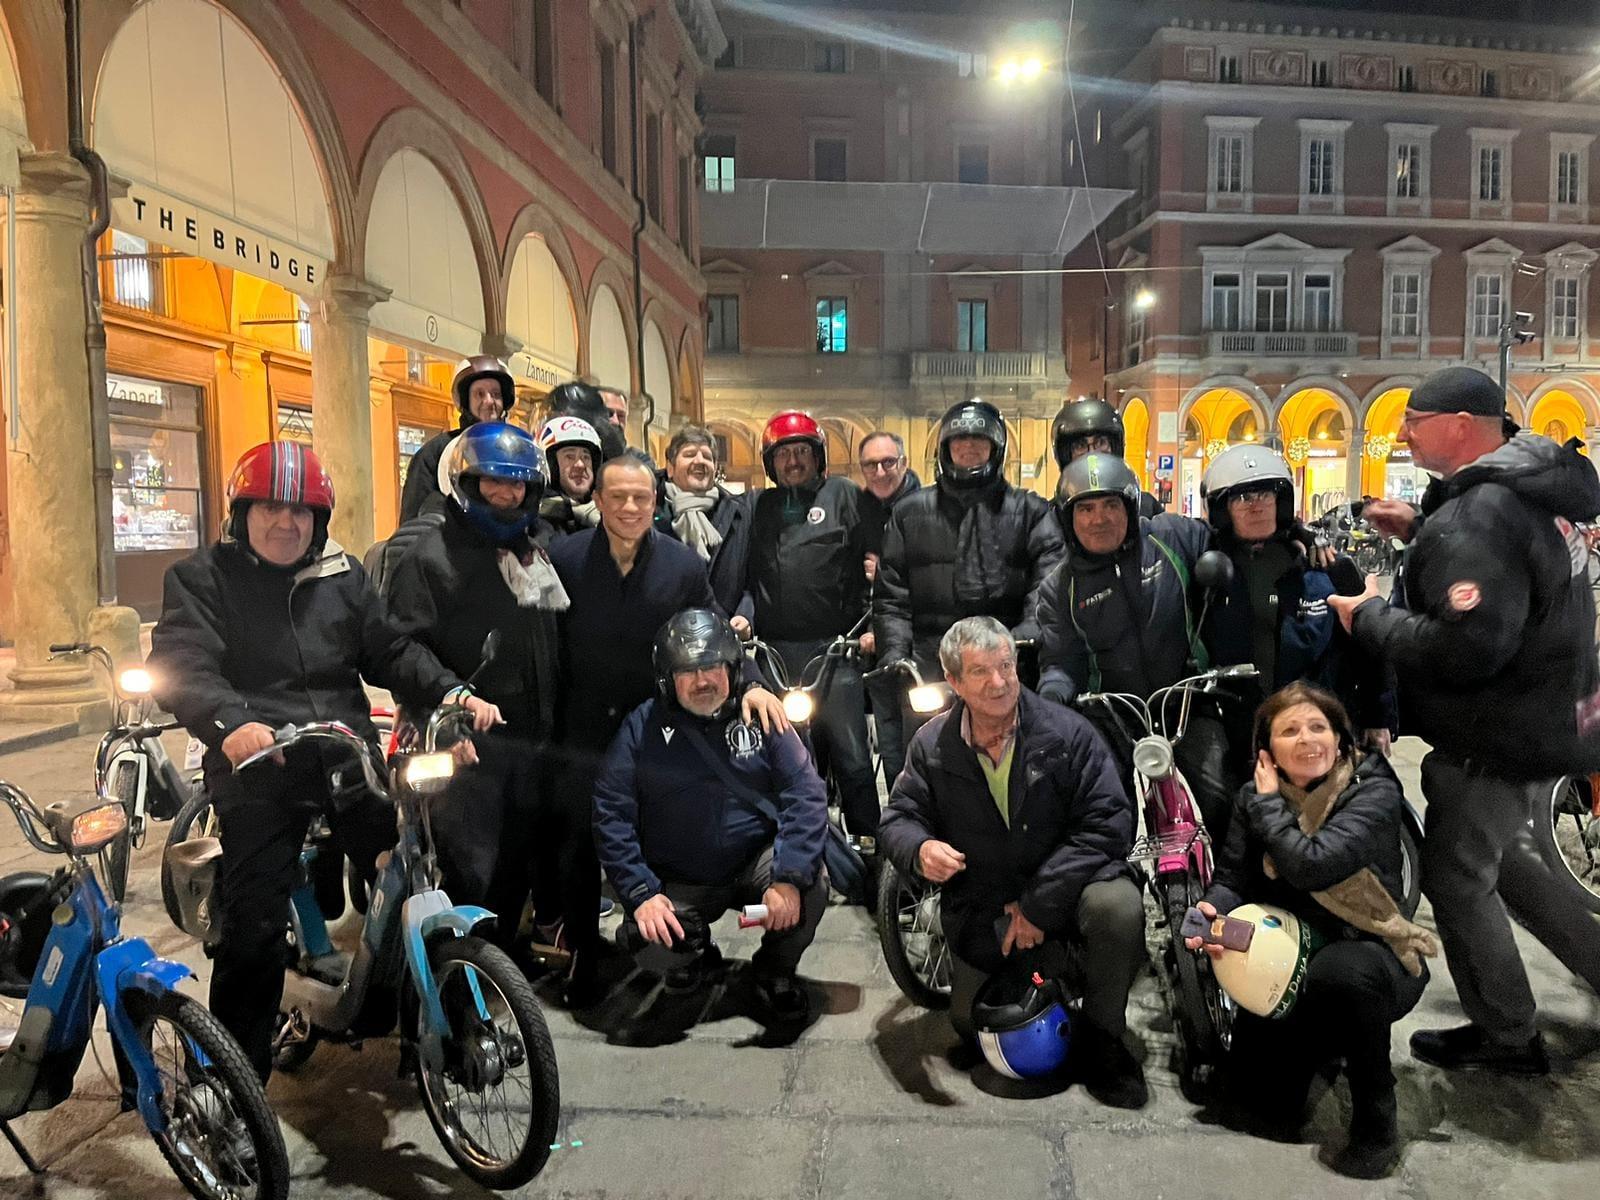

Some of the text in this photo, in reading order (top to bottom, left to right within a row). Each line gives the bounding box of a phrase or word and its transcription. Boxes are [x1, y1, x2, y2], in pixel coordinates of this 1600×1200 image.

[132, 197, 315, 283] THE BRIDGE
[1161, 456, 1171, 469] P
